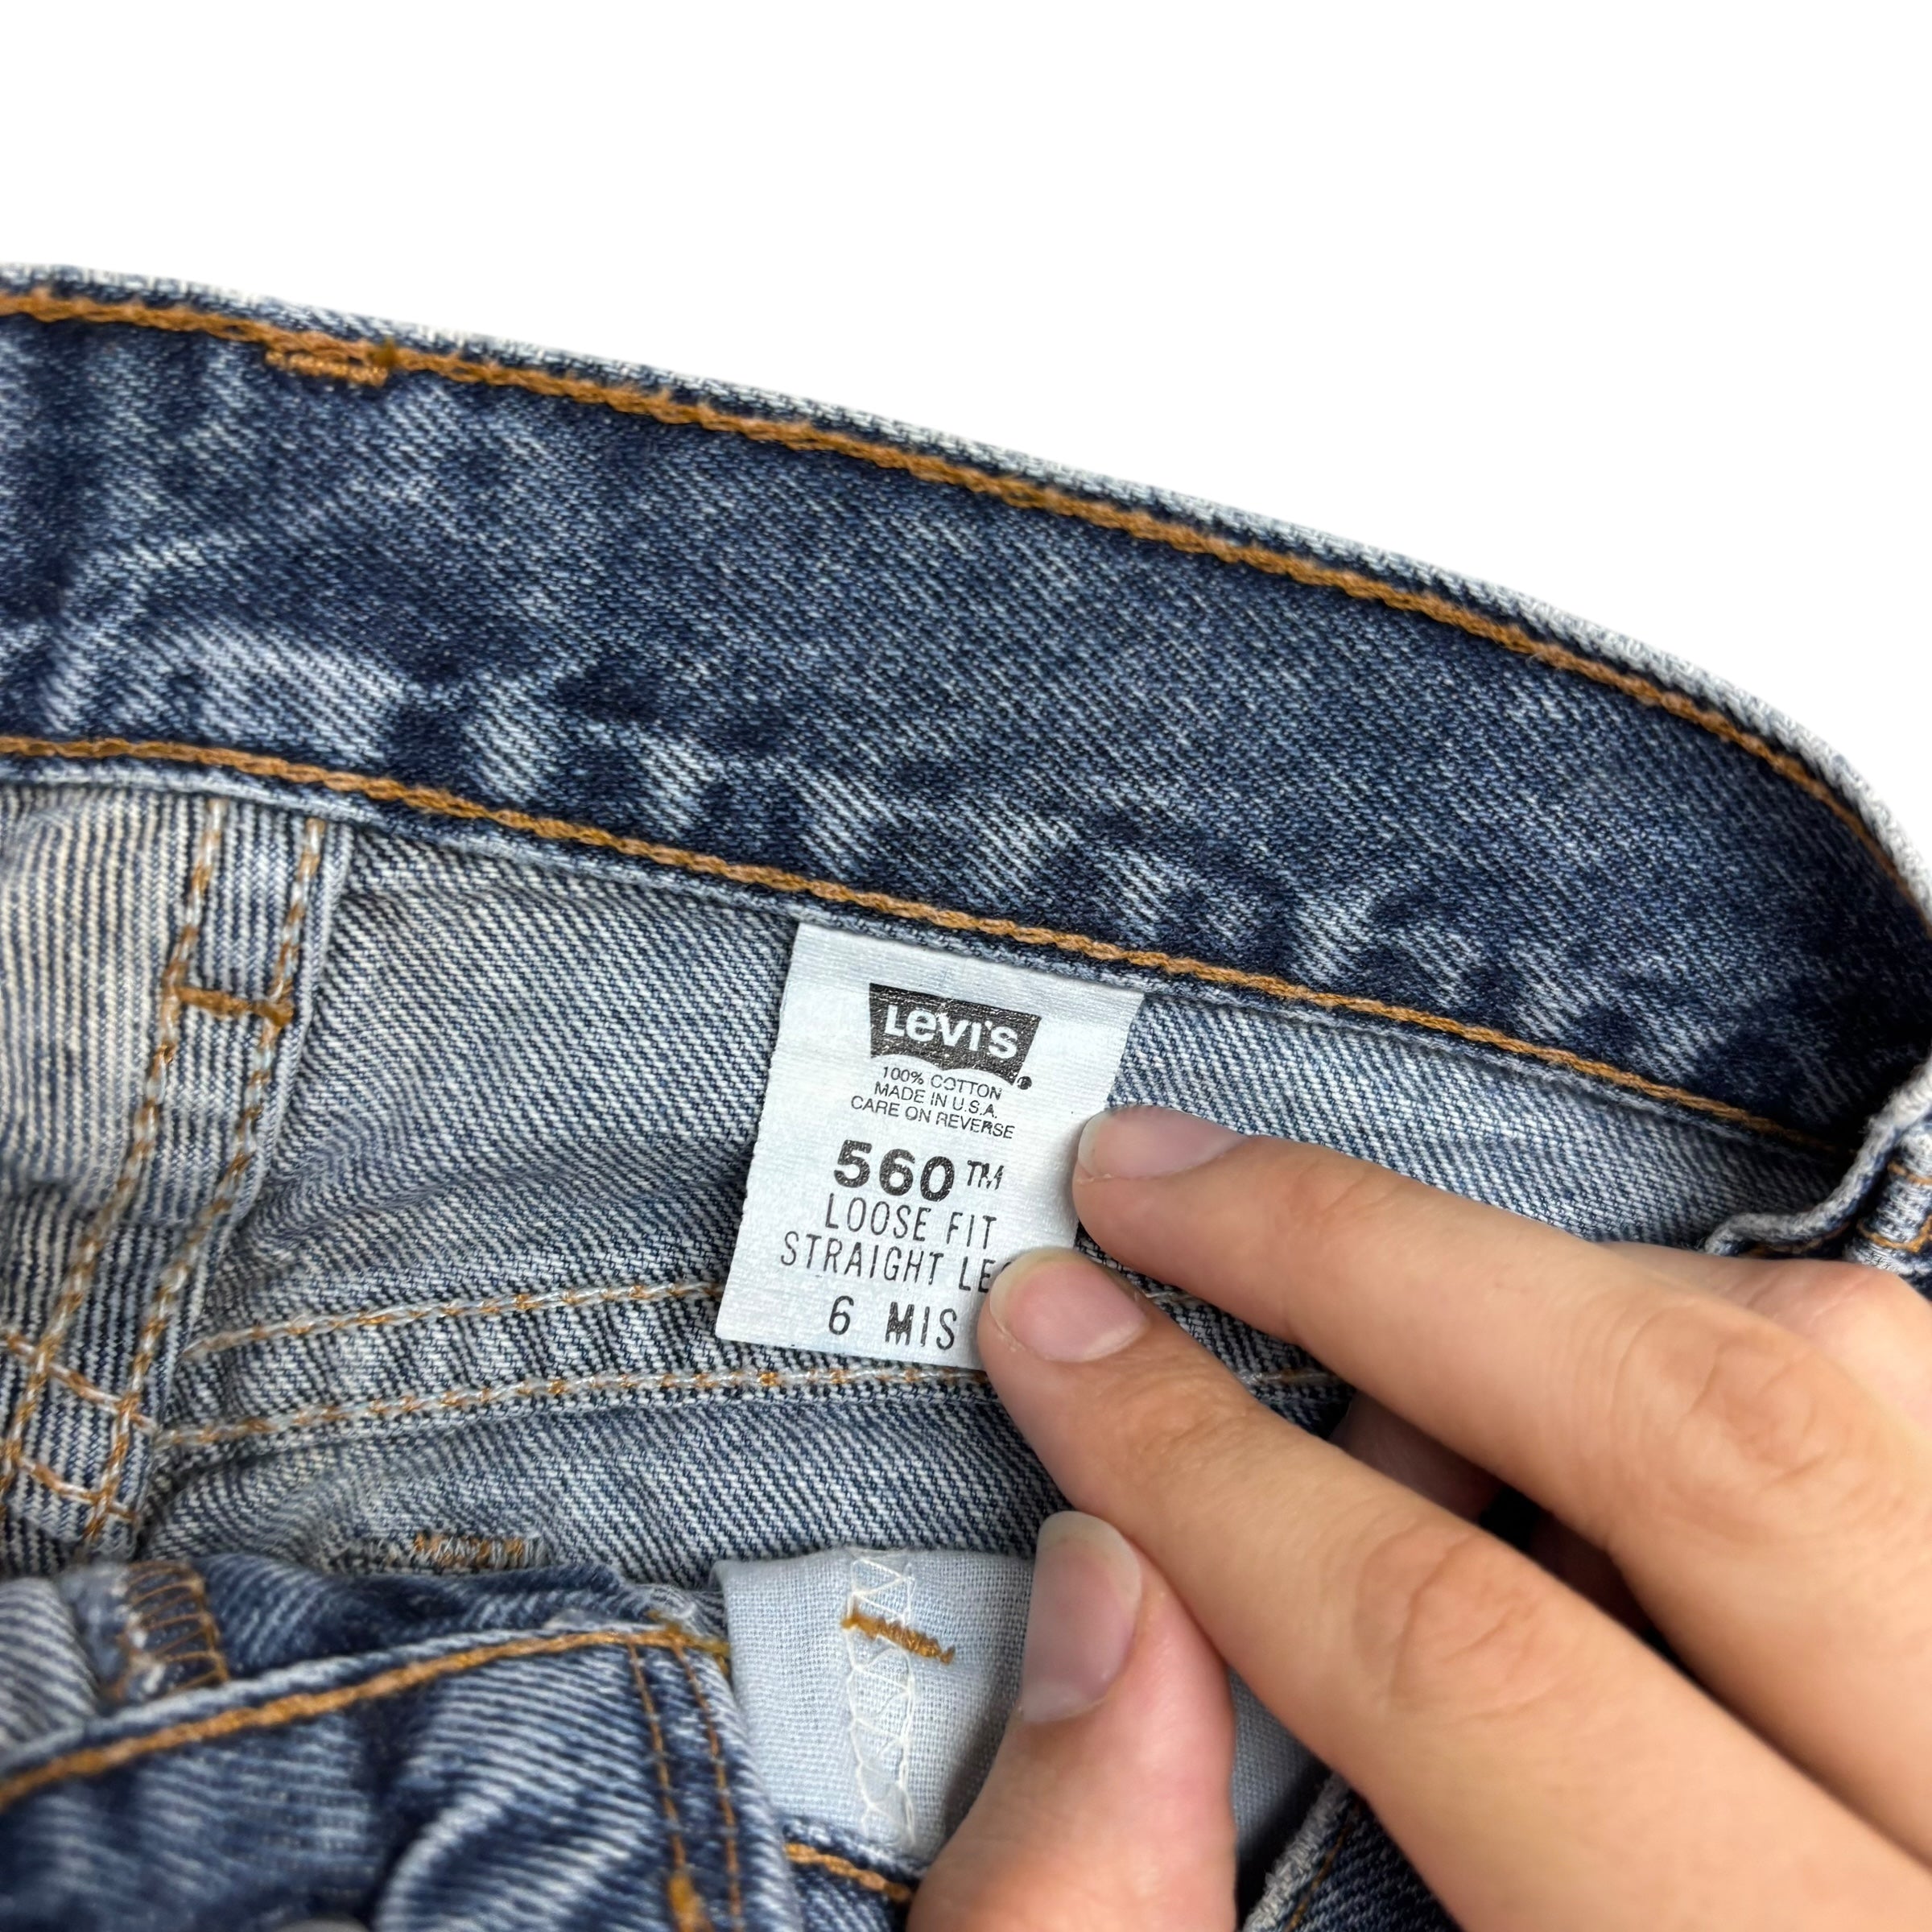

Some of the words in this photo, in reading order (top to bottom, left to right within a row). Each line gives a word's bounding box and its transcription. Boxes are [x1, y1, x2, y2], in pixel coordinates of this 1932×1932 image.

[874, 1081, 926, 1104] MADE
[931, 1093, 947, 1108] IN
[952, 1097, 998, 1119] U.S.A.
[883, 1066, 925, 1085] 100%
[931, 1074, 1002, 1100] COTTON
[851, 1095, 901, 1117] CARE
[905, 1106, 931, 1124] ON
[936, 1111, 1016, 1139] REVERSE
[825, 1192, 932, 1242] LOOSE
[946, 1211, 997, 1249] FIT
[780, 1231, 944, 1286] STRAIGHT
[958, 1256, 1011, 1294] LE
[828, 1294, 855, 1335] 6
[885, 1301, 958, 1351] MIS
